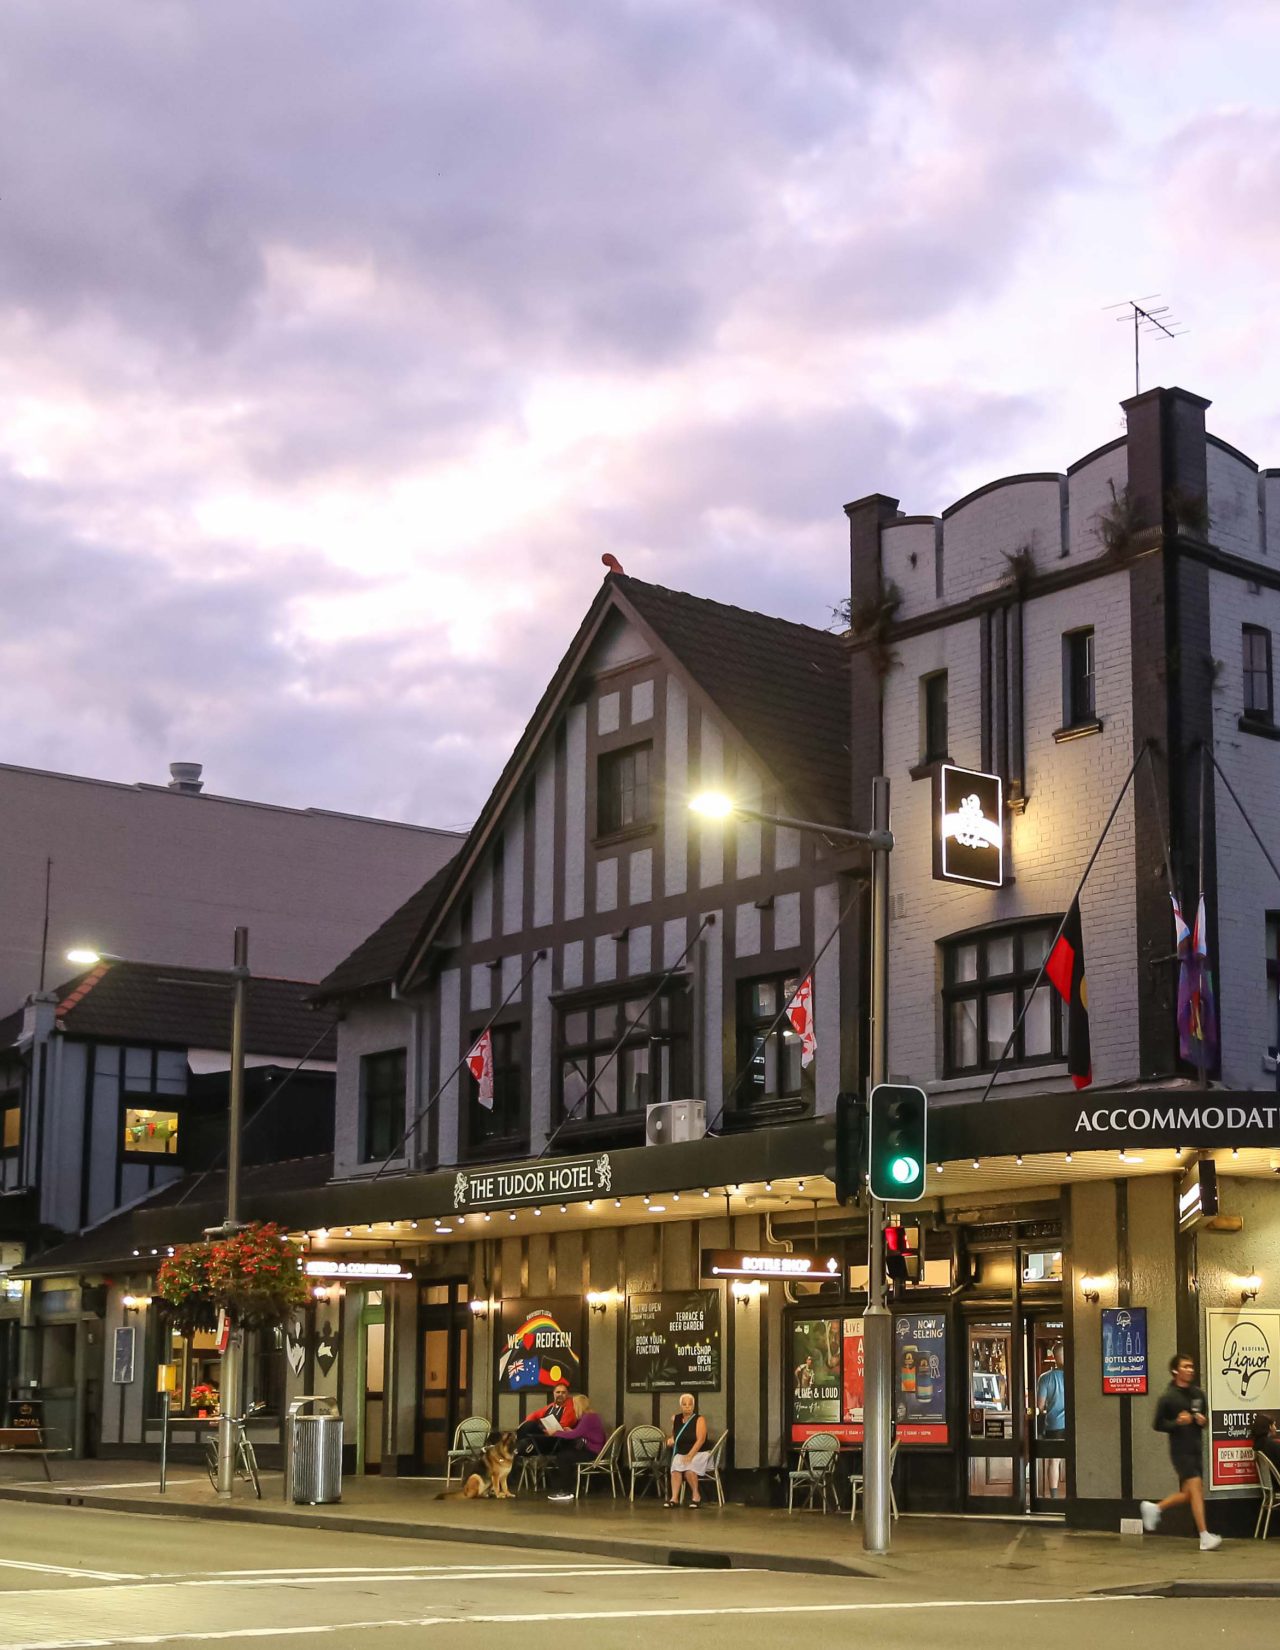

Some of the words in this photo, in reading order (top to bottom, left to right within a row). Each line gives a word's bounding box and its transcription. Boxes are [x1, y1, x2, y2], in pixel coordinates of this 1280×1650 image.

[470, 1178, 494, 1200] THE
[498, 1172, 544, 1196] TUDOR
[549, 1166, 594, 1190] HOTEL
[742, 1257, 781, 1270] BOTTLE
[782, 1258, 811, 1272] SHOP
[648, 1303, 661, 1312] OPEN
[676, 1312, 698, 1321] TERRACE
[669, 1322, 682, 1331] BEER
[683, 1321, 704, 1330] GARDEN
[845, 1322, 860, 1333] LIVE
[918, 1320, 936, 1329] NOW
[913, 1328, 943, 1339] SELLING
[507, 1333, 520, 1349] WE
[536, 1332, 572, 1348] REDFERN
[636, 1336, 648, 1345] BOOK
[650, 1335, 663, 1344] YOUR
[636, 1345, 660, 1354] FUNCTION
[678, 1345, 711, 1356] BOTTLESHOP
[697, 1356, 711, 1364] OPEN
[814, 1387, 820, 1398] &
[821, 1387, 839, 1399] LOUD
[1224, 1413, 1250, 1426] BOTTLE
[1228, 1426, 1246, 1437] Support
[1220, 1451, 1234, 1460] OPEN
[1240, 1450, 1253, 1459] DAYS
